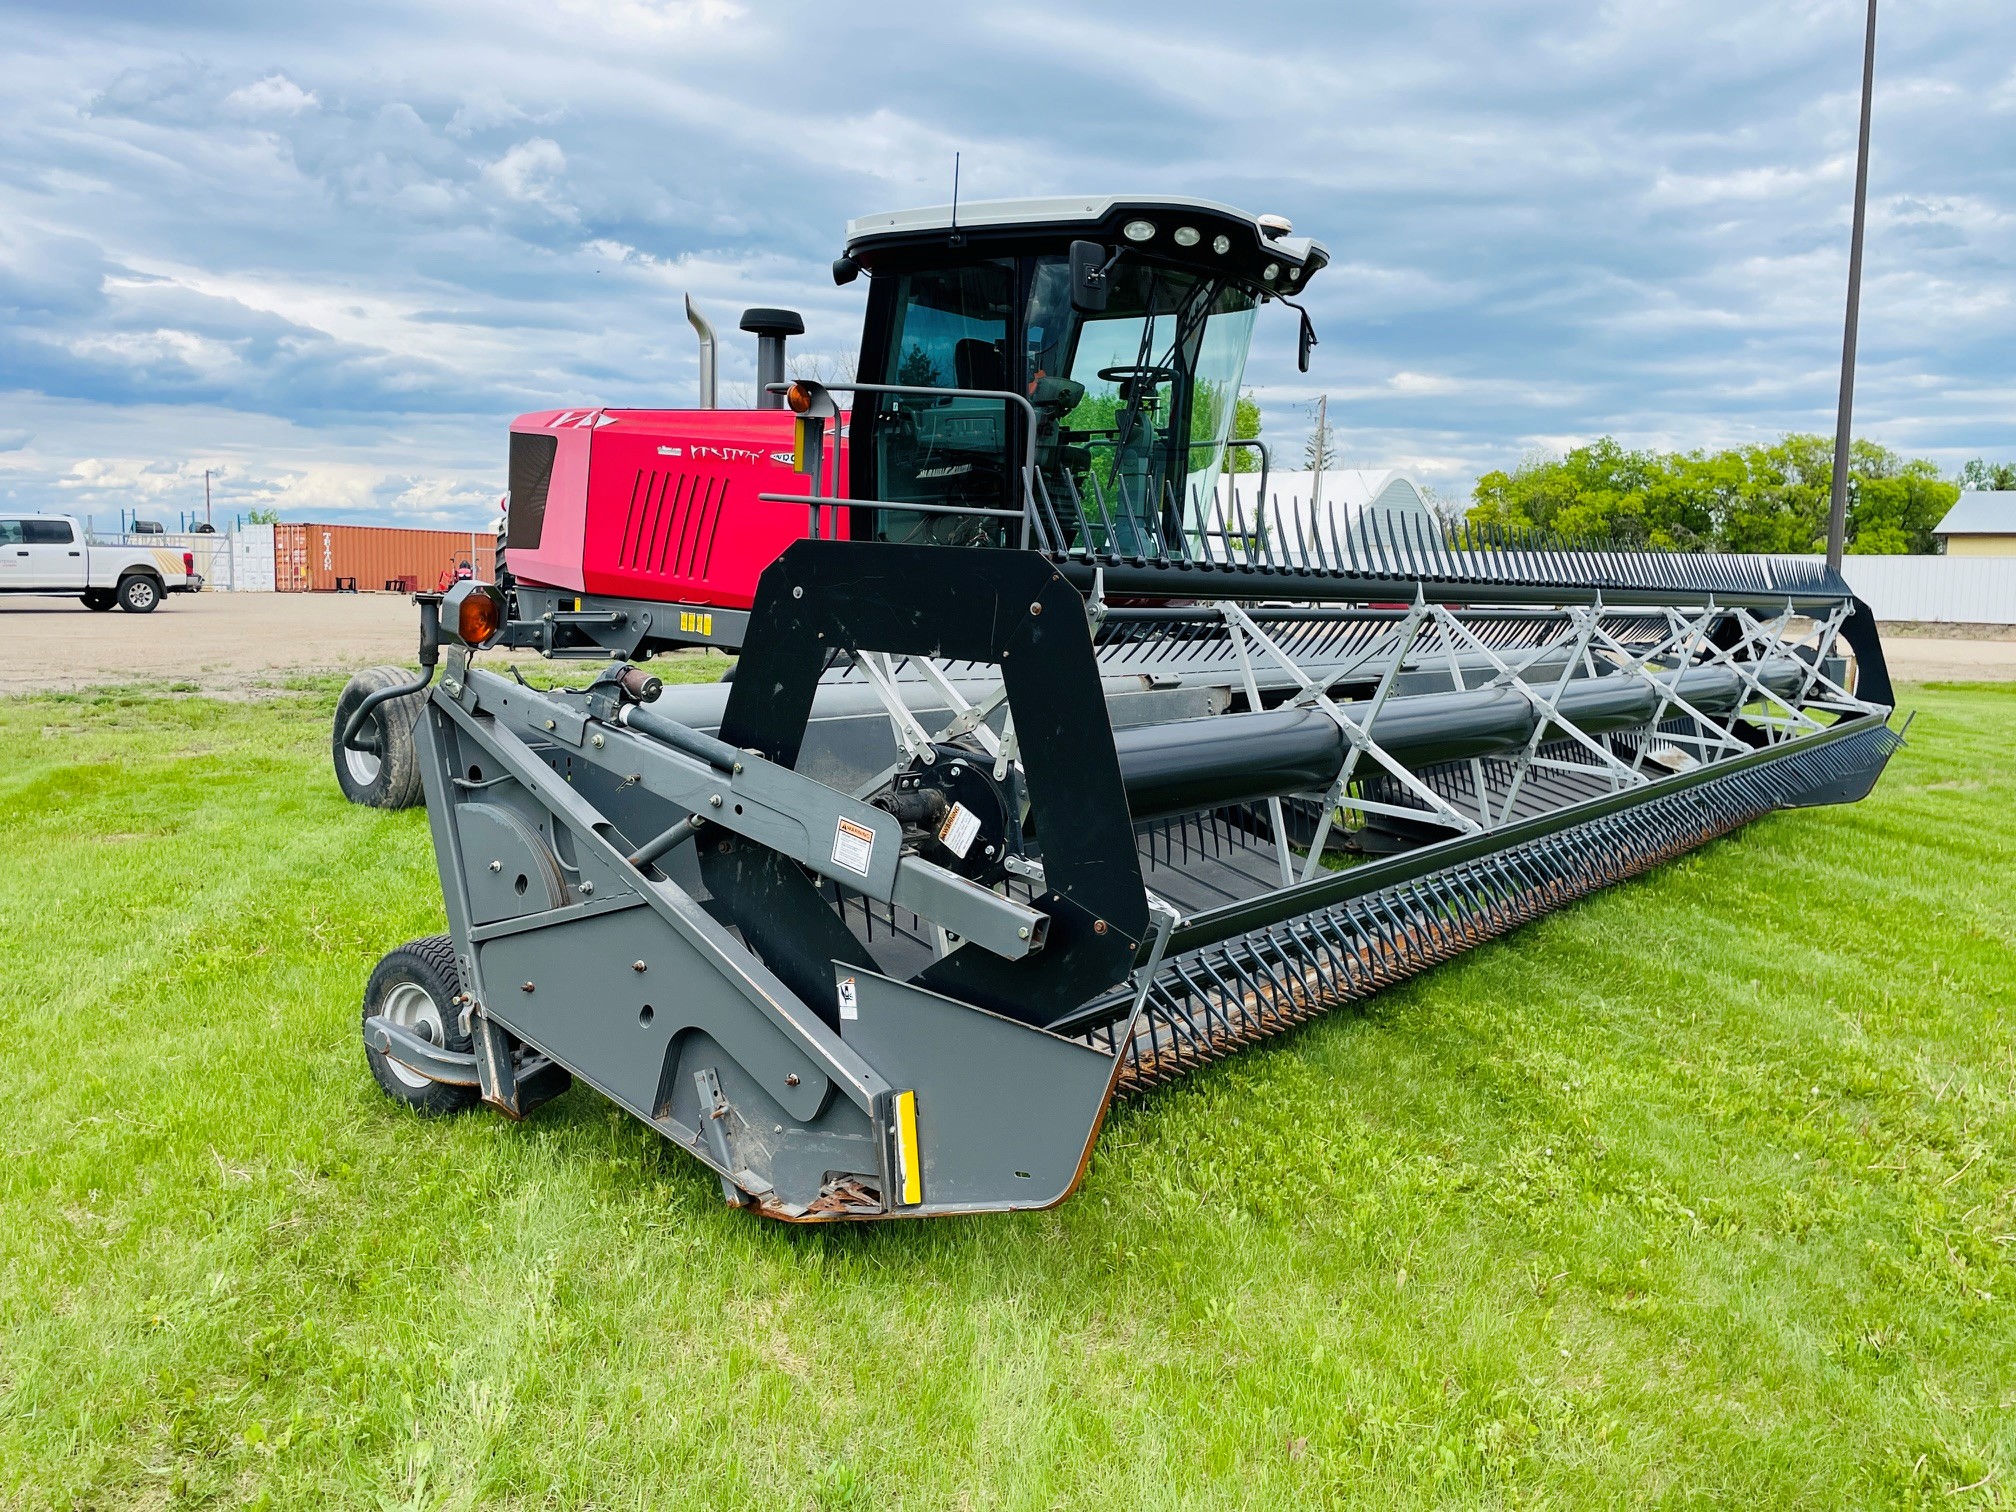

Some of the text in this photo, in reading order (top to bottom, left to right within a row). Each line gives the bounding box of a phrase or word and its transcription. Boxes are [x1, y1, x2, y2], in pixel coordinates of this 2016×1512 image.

[323, 532, 332, 570] TRITON
[846, 825, 871, 840] WARNING
[942, 806, 960, 835] WARNING
